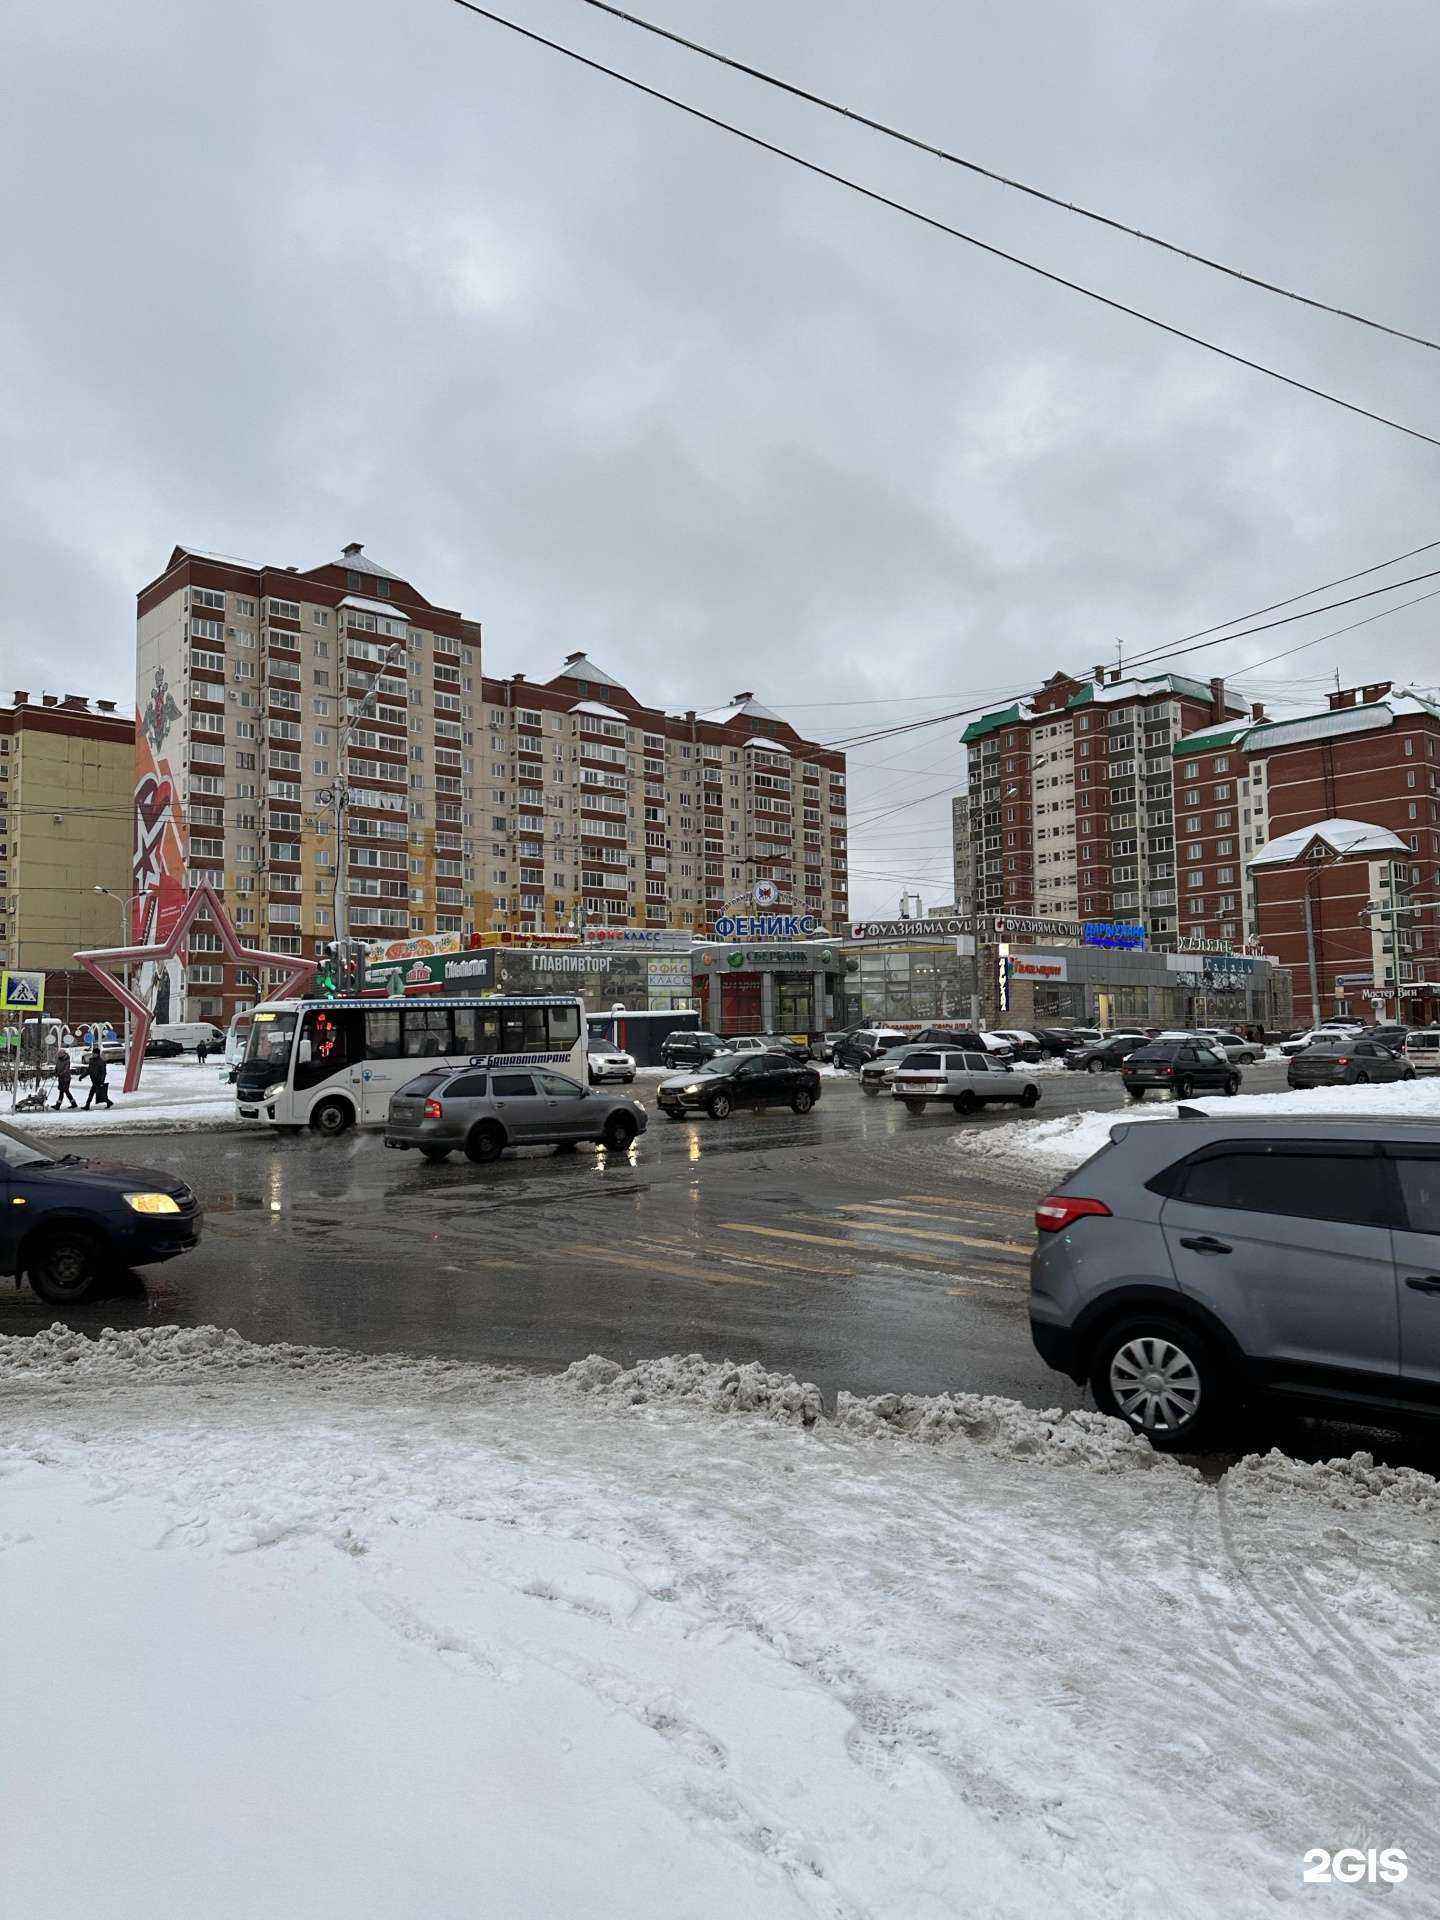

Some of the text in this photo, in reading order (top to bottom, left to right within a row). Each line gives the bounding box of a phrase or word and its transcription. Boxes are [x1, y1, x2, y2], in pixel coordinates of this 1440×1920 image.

[715, 914, 818, 938] ФЕНИКС
[867, 922, 944, 936] ФУДЗИЯМА
[1006, 919, 1057, 934] ФУДЗИЯМА
[1058, 922, 1084, 936] СУШИ
[746, 950, 808, 962] СБЕРБАНК
[531, 955, 612, 973] ГЛАВПИВТОРГ
[648, 962, 689, 974] ОФИС
[649, 976, 691, 985] КЛАСС
[488, 1053, 571, 1067] Башавтотранс
